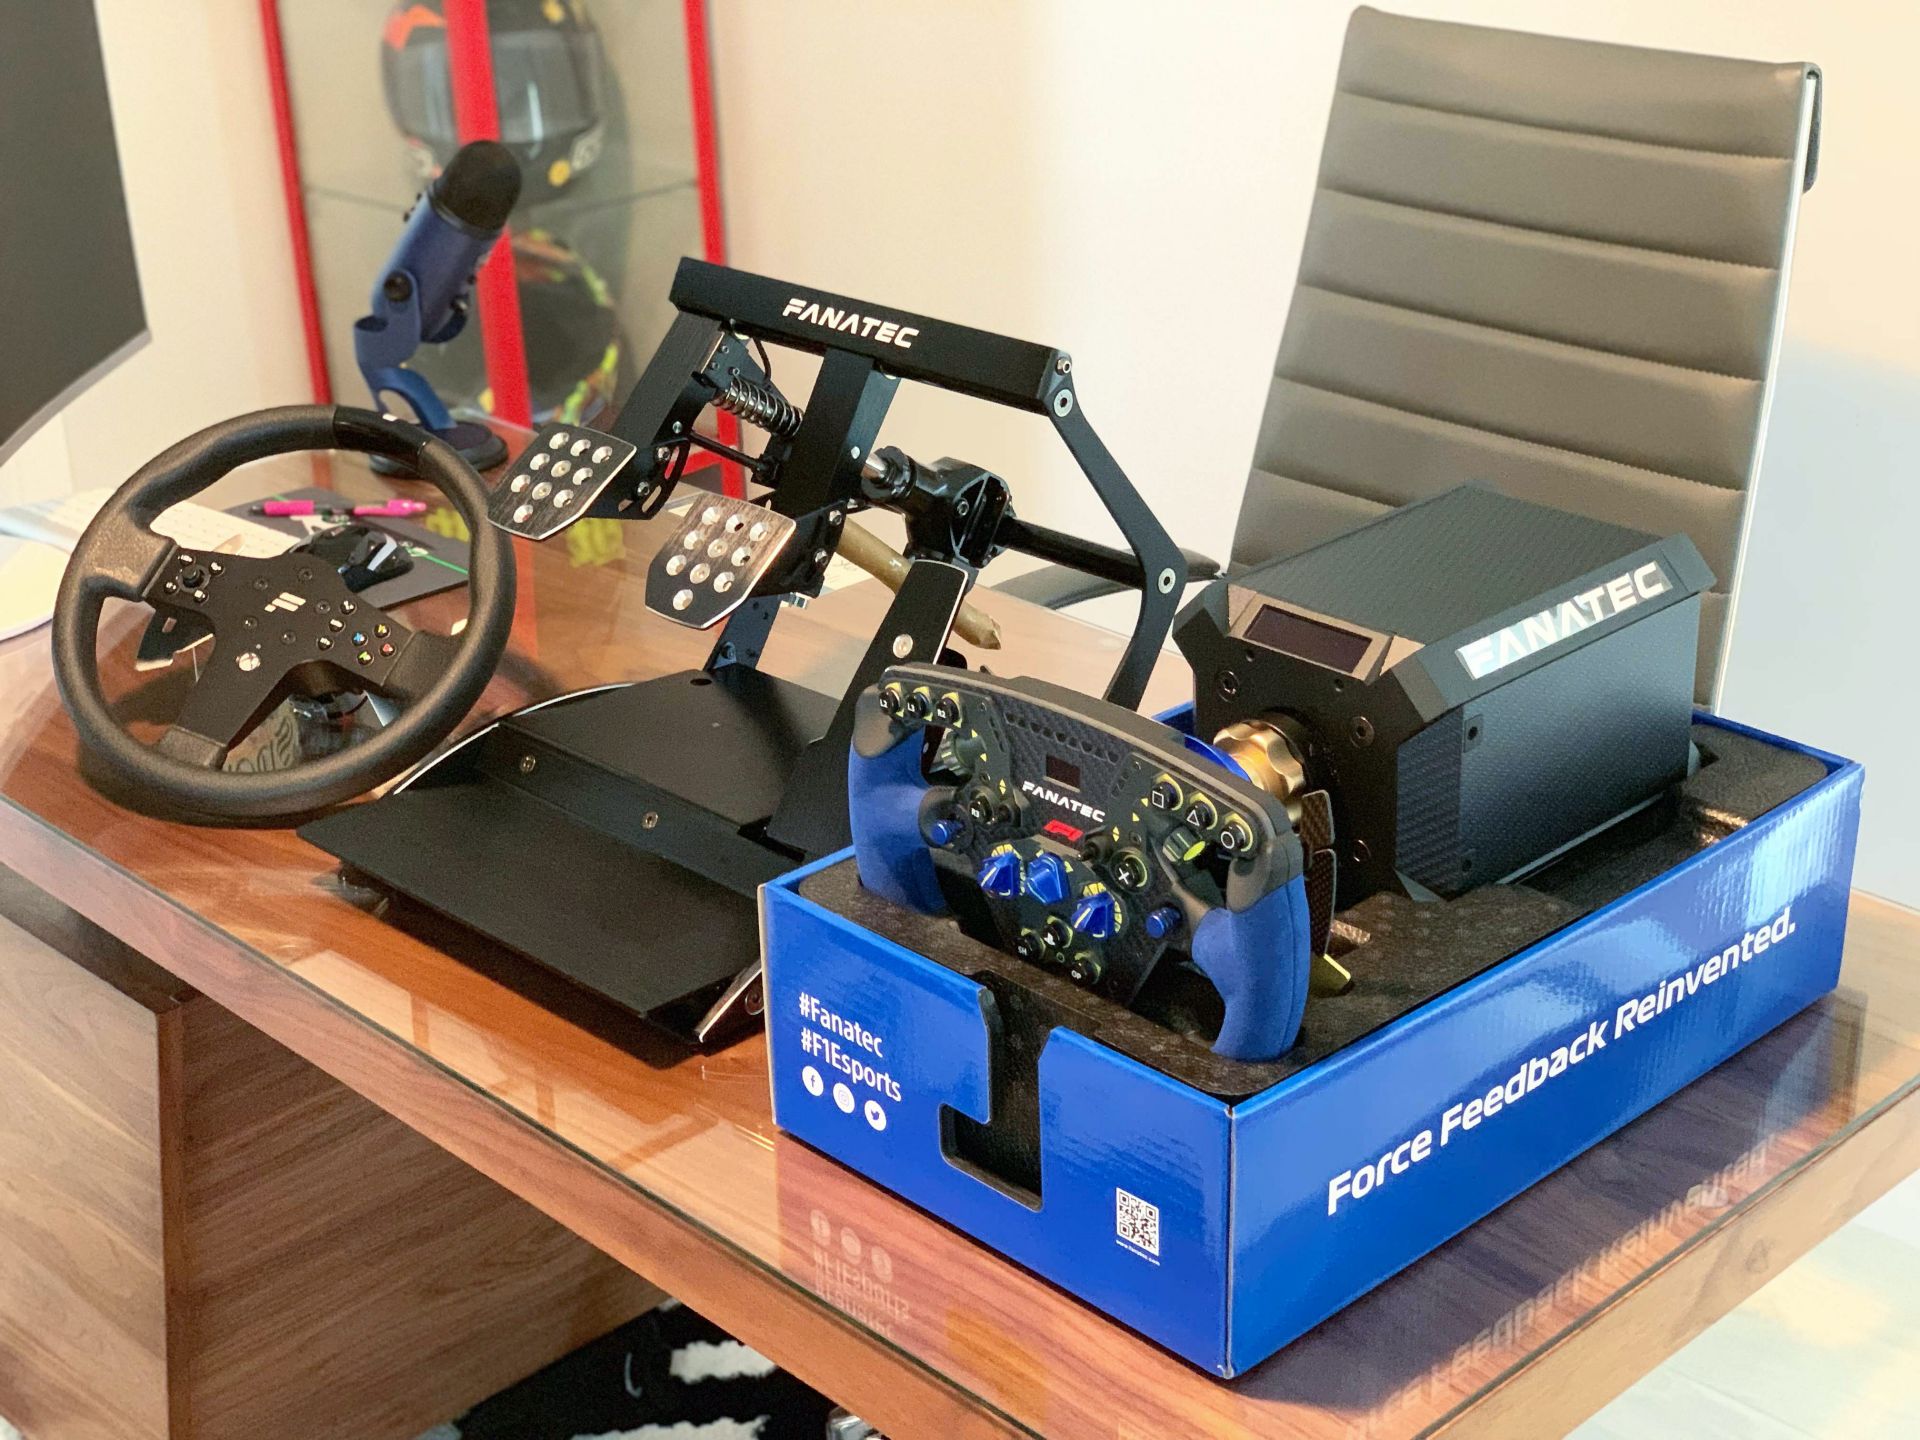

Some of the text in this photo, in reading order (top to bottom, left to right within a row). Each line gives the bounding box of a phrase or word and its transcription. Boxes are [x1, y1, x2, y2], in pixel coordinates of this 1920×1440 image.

[782, 297, 920, 349] FANATEC
[1460, 561, 1664, 680] FANATEC
[937, 708, 946, 719] R2
[1021, 780, 1106, 823] FANATEC
[799, 991, 883, 1058] #Fanatec
[800, 1028, 902, 1102] #F1Esports
[1327, 906, 1796, 1216] Force Feedback Reinvented.
